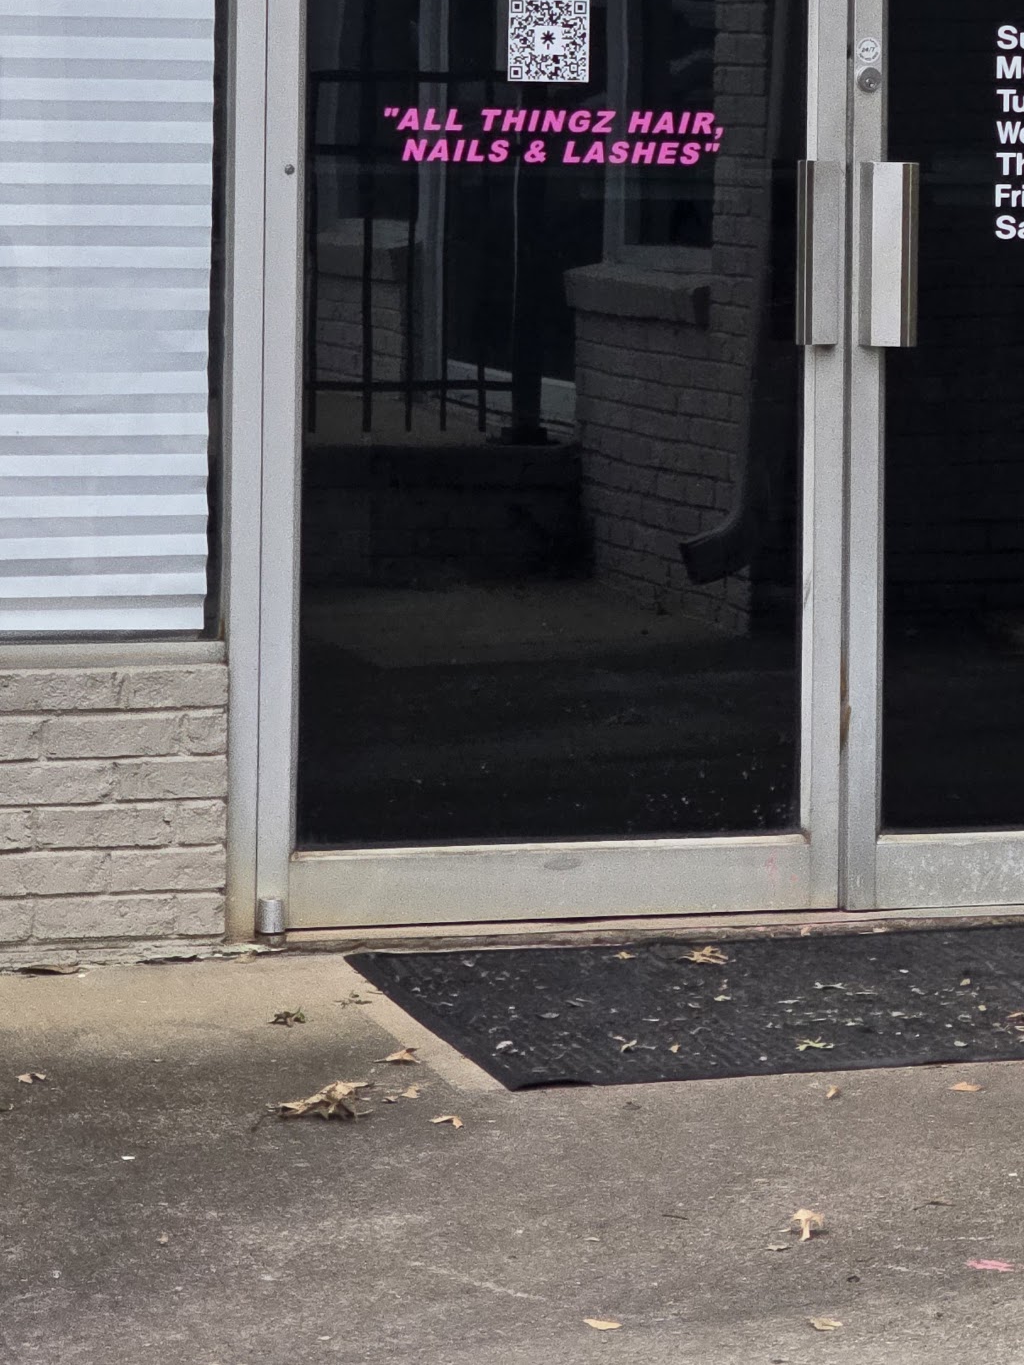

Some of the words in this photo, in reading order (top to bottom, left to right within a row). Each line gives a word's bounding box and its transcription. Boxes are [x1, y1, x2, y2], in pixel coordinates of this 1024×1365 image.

[383, 107, 464, 132] "ALL
[481, 109, 617, 134] THINGZ
[627, 111, 724, 140] HAIR,
[401, 138, 510, 163] NAILS
[523, 140, 547, 163] &
[562, 135, 722, 165] LASHES"
